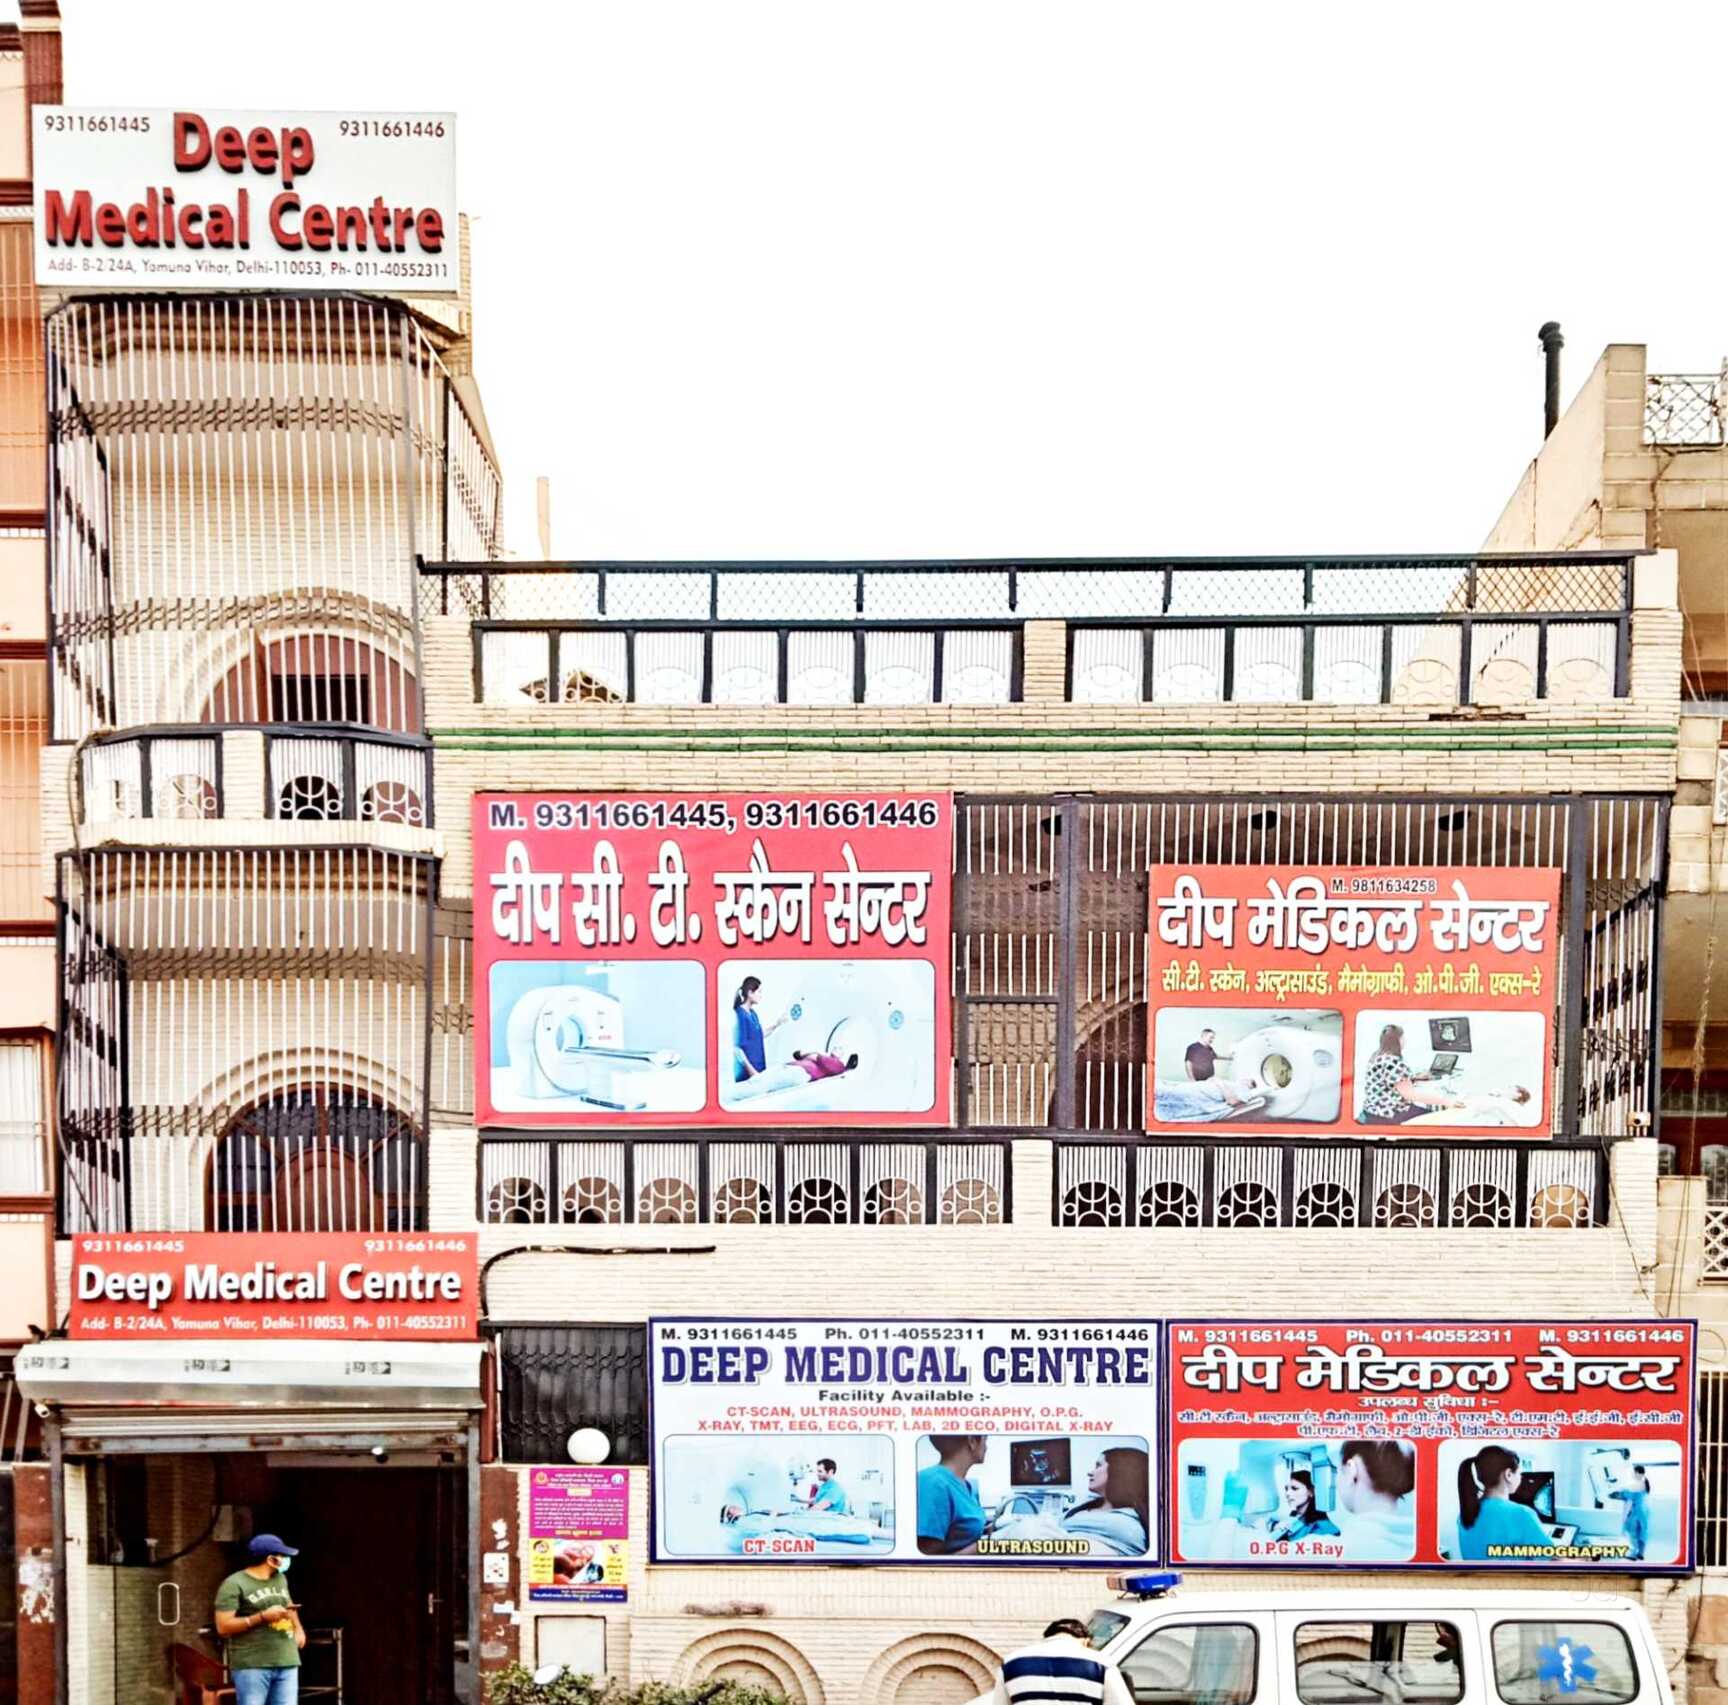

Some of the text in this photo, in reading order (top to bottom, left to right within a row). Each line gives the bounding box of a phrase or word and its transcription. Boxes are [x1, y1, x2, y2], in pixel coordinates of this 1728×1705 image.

[44, 116, 150, 132] 9311661445
[339, 120, 445, 138] 9311661446
[173, 112, 315, 189] Deep
[44, 186, 445, 253] Medical Centre
[48, 258, 78, 271] Add-
[82, 258, 137, 273] B-224A,
[142, 259, 191, 273] Yamuna
[237, 260, 325, 278] Delhi-110053,
[331, 262, 351, 276] Ph-
[355, 262, 448, 278] 011-40552311
[490, 800, 937, 832] M. 9311661445, 9311661446
[490, 837, 932, 947] दीप सी. टी. स्कैन सेन्टर
[1331, 878, 1438, 894] M. 9811634258
[1157, 875, 1551, 954] दीप मेडिकल सेन्टर
[82, 1239, 184, 1254] 9311661445
[364, 1239, 466, 1254] 9311661446
[77, 1260, 462, 1308] Deep Medical Centre
[81, 1317, 110, 1331] Add-
[172, 1317, 220, 1331] Yamuna
[224, 1316, 259, 1332] Vihar,
[262, 1316, 349, 1332] Delhi-110053,
[353, 1316, 374, 1331] Ph-
[377, 1316, 467, 1331] 011-40552311
[660, 1328, 798, 1342] M. 9311661445
[824, 1327, 985, 1342] Ph. 011-40552311
[1010, 1328, 1149, 1342] M. 9311661446
[1178, 1329, 1319, 1343] M. 9311661445
[1346, 1328, 1513, 1343] Ph. 011-40552311
[1538, 1329, 1685, 1344] M. 9311661446
[661, 1345, 1151, 1387] DEEP MEDICAL CENTRE
[1182, 1344, 1681, 1394] दीप मेडिकल सेन्टर
[818, 1389, 885, 1404] Facility
[891, 1389, 973, 1402] Available
[726, 1406, 1084, 1419] CT-SCAN, ULTRASOUND, MAMMOGRAPHY, O.P.G.
[698, 1420, 1112, 1433] X-RAY, TMT, EEG, ECG, PFT, LAB, 2D ECO, DIGITAL X-RAY
[977, 1539, 1090, 1555] ULTRASOUND
[1249, 1541, 1344, 1558] O.P.G X-Ray
[1488, 1543, 1628, 1559] MAMMOGRAPHY
